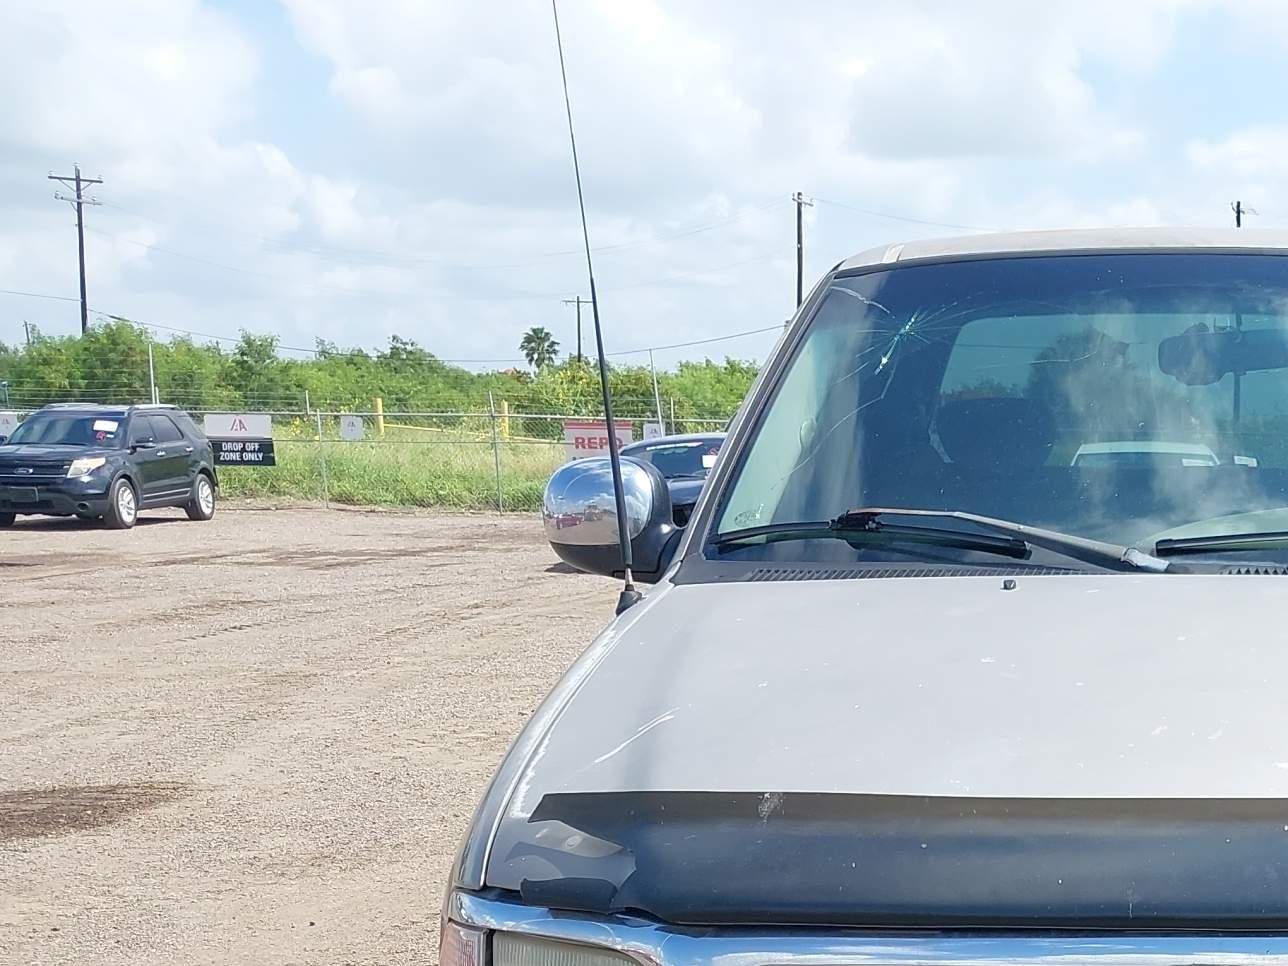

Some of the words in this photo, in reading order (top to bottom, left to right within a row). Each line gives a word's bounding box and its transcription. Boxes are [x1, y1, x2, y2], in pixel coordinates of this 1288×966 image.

[222, 442, 244, 451] DROP
[245, 442, 260, 451] OFF
[219, 452, 242, 461] ZONE
[243, 452, 264, 461] ONLY
